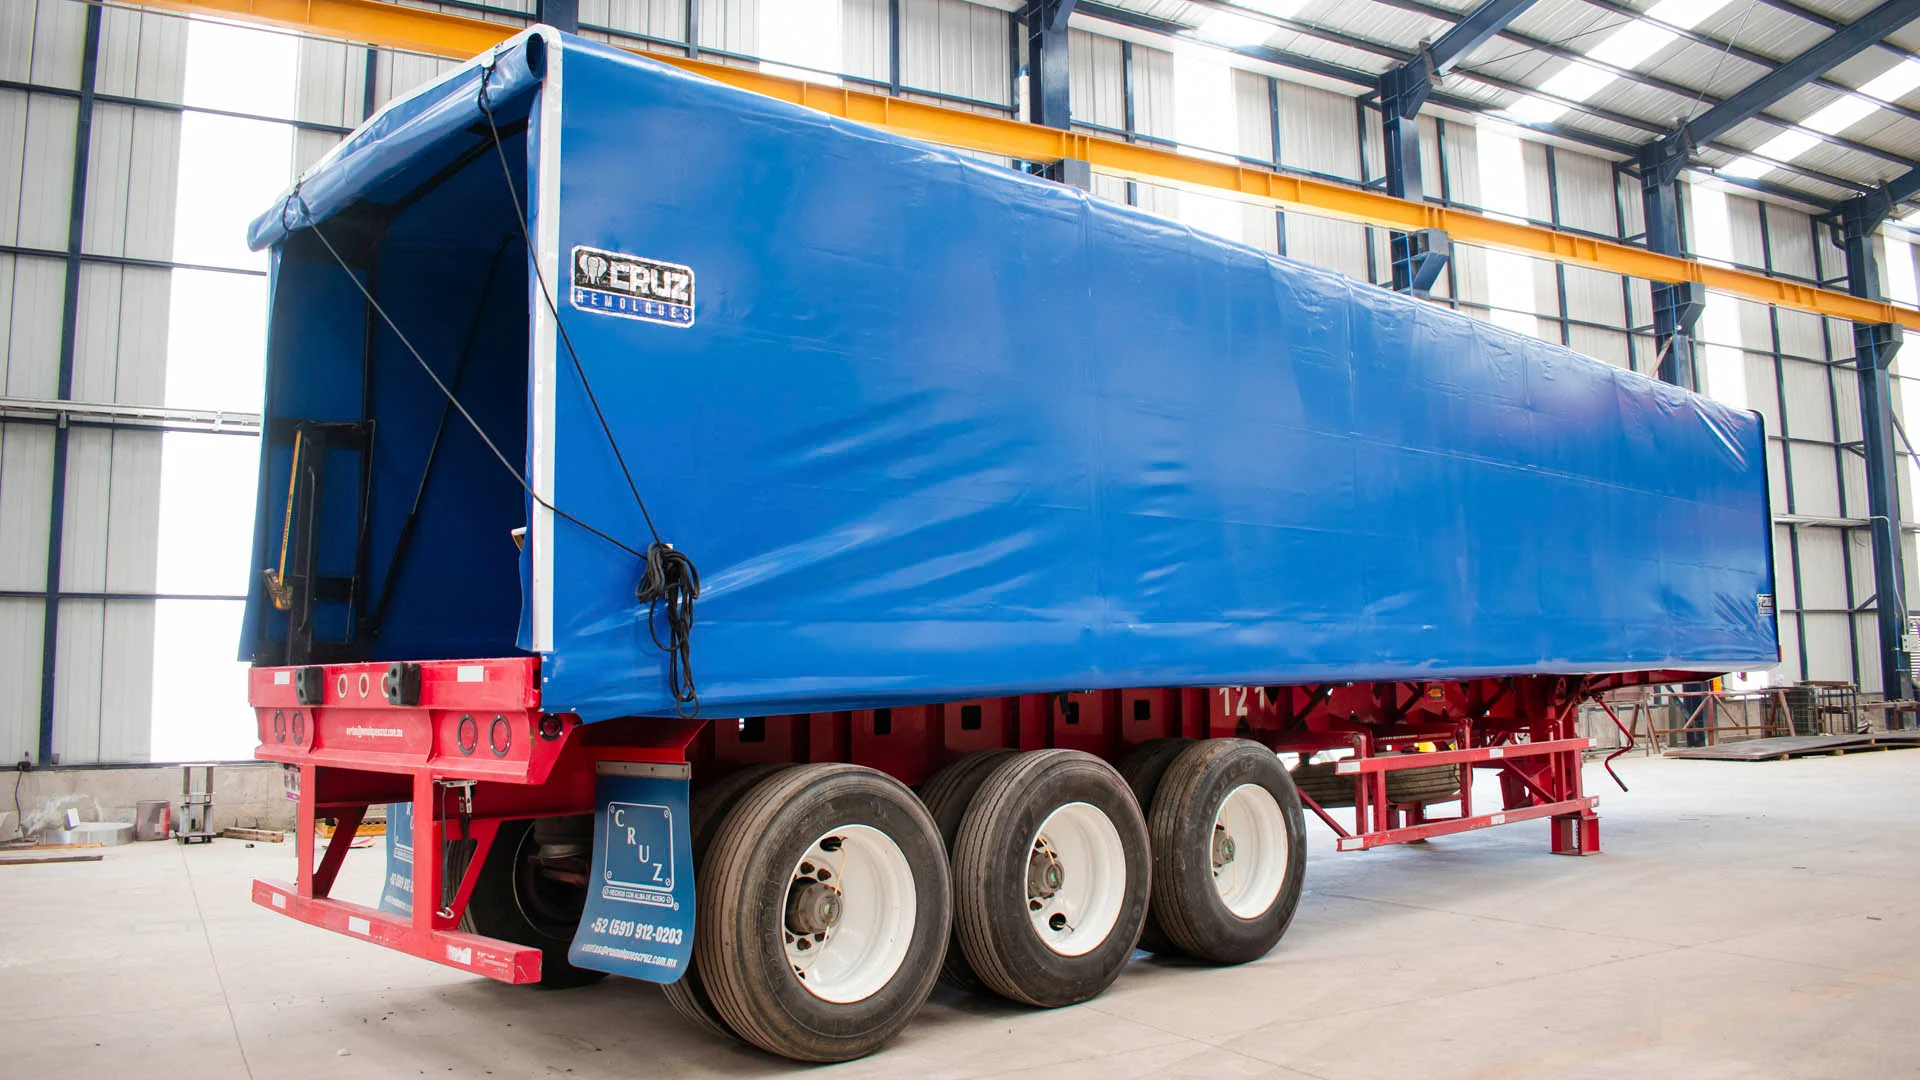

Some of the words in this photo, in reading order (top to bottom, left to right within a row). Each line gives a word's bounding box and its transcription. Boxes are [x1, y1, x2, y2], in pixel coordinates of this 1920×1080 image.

[610, 260, 689, 302] CRUZ
[576, 290, 690, 321] REMOLQUES
[591, 917, 609, 933] +52
[609, 919, 635, 938] (591)
[635, 923, 683, 945] 912-0203
